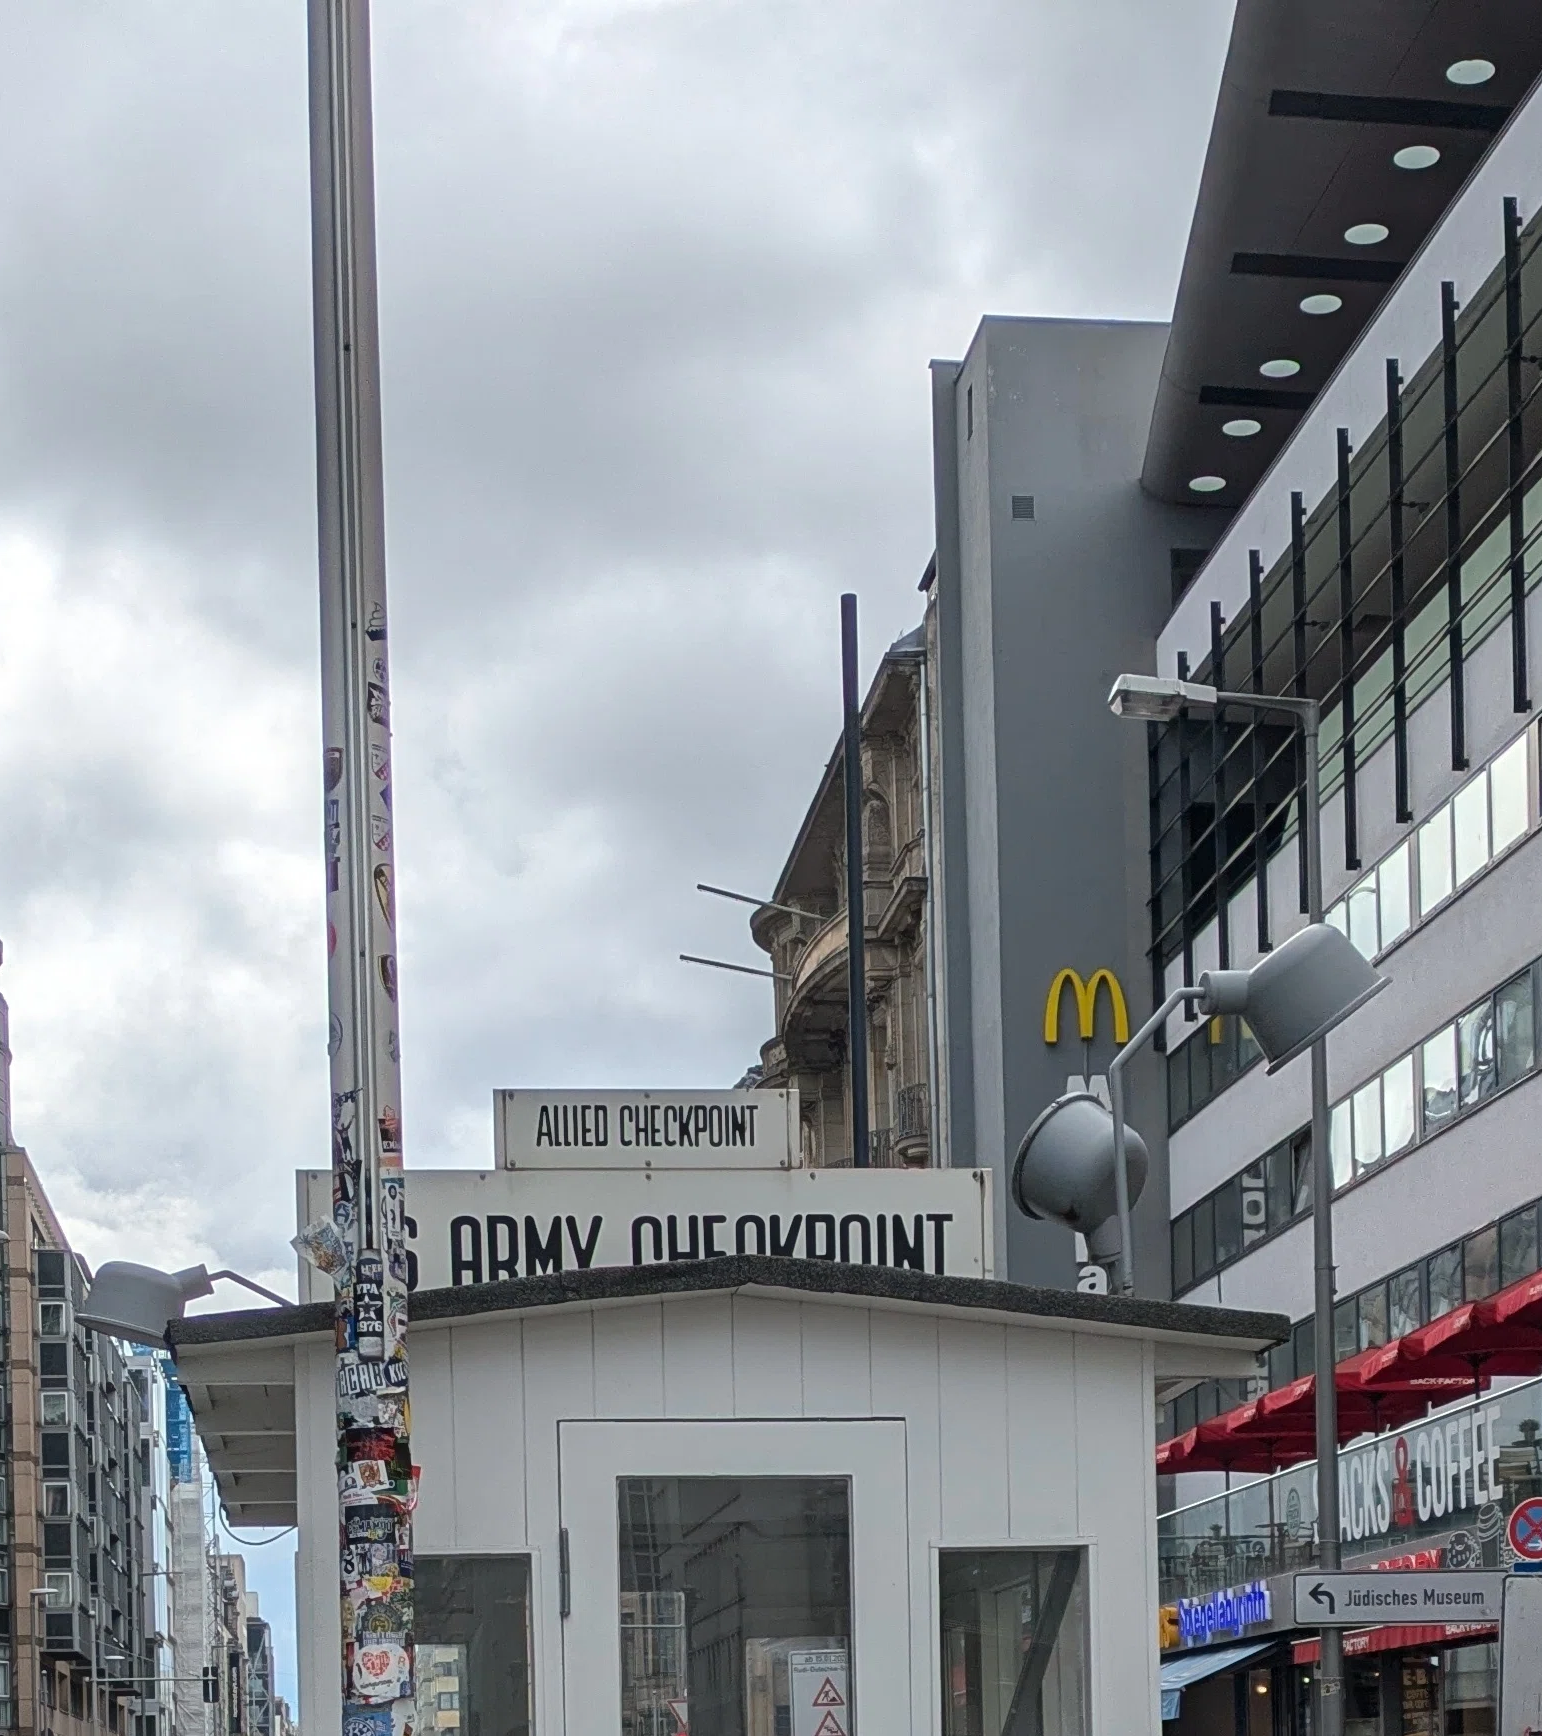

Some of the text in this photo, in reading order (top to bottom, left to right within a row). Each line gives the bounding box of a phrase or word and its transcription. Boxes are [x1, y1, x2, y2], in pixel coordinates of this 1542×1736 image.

[536, 1104, 759, 1148] ALLIED CHECKPOINT
[450, 1213, 602, 1286] ARMY
[632, 1213, 954, 1277] CHECKPOINT
[1313, 1446, 1391, 1545] ACKS
[1416, 1405, 1504, 1522] COFFEE
[1344, 1588, 1485, 1607] Jüdisches Museum
